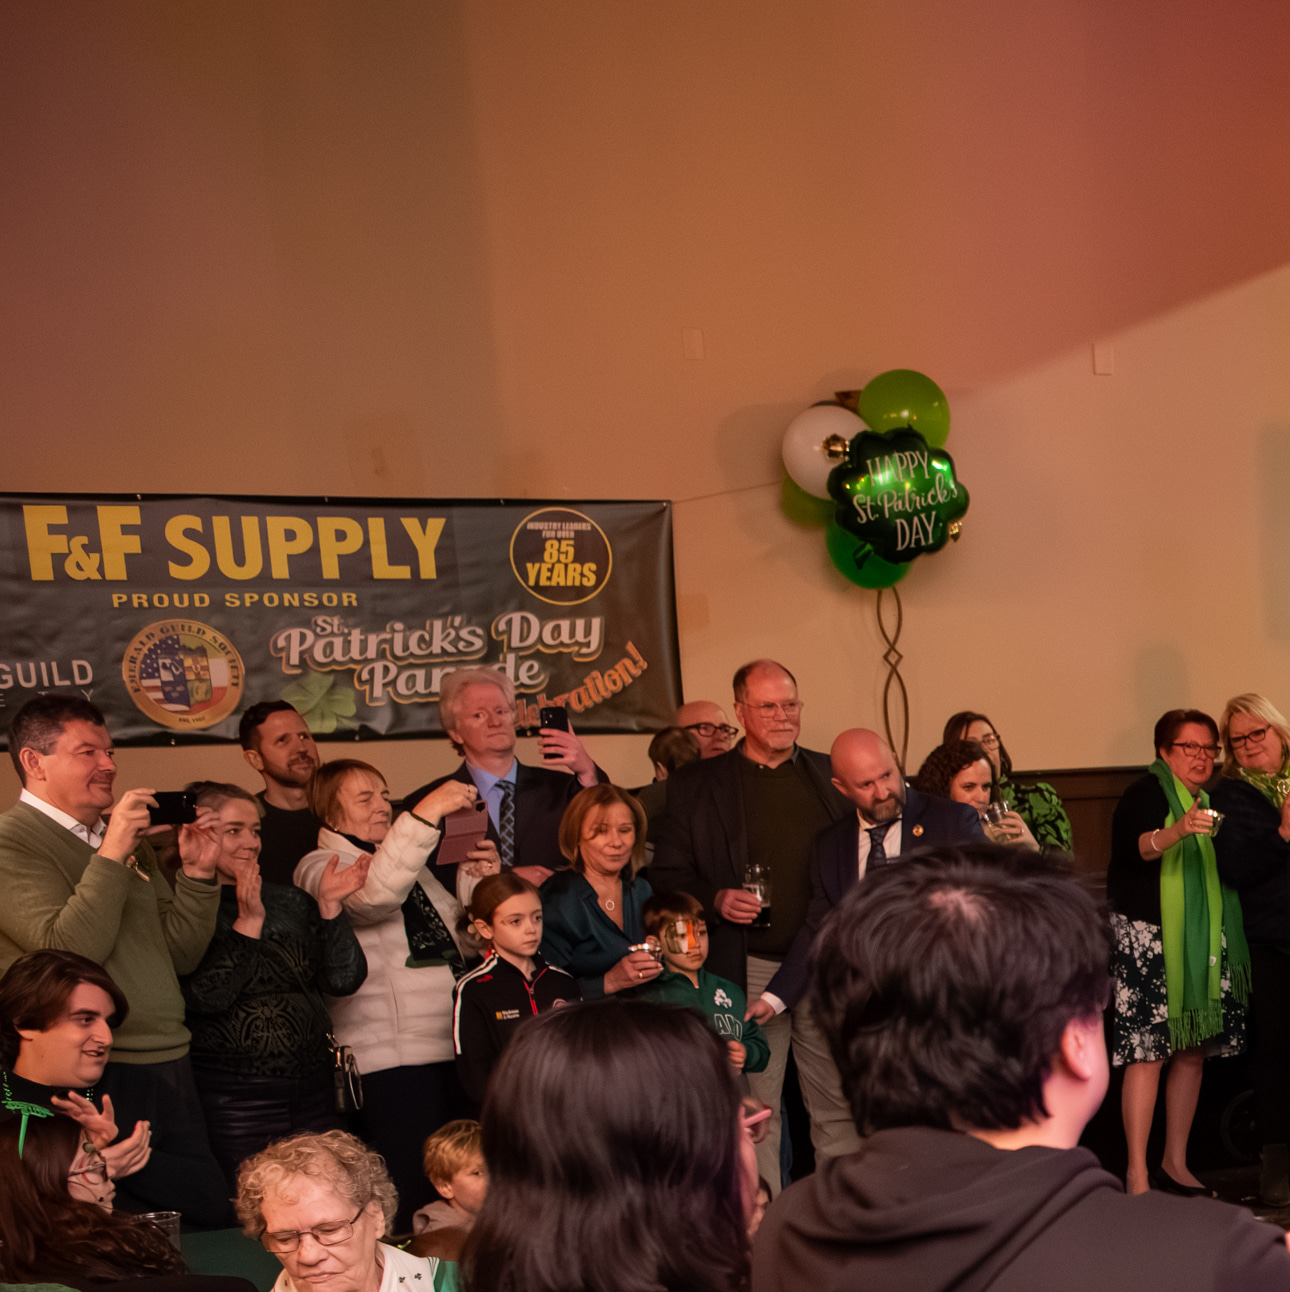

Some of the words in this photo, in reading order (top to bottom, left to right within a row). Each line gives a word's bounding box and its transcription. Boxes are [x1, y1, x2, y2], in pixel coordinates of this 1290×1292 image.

[866, 451, 930, 486] HAPPY
[22, 505, 142, 581] F&F
[164, 514, 446, 581] SUPPLY
[896, 511, 937, 551] DAY
[543, 539, 575, 563] 85
[526, 562, 597, 587] YEARS
[112, 593, 210, 608] PROUD
[224, 592, 358, 608] SPONSOR
[160, 624, 207, 636] GUILD
[275, 615, 486, 668] Patrick's
[496, 611, 603, 657] Day
[315, 616, 349, 635] St.
[0, 660, 93, 689] GUILD
[361, 654, 547, 698] Parde
